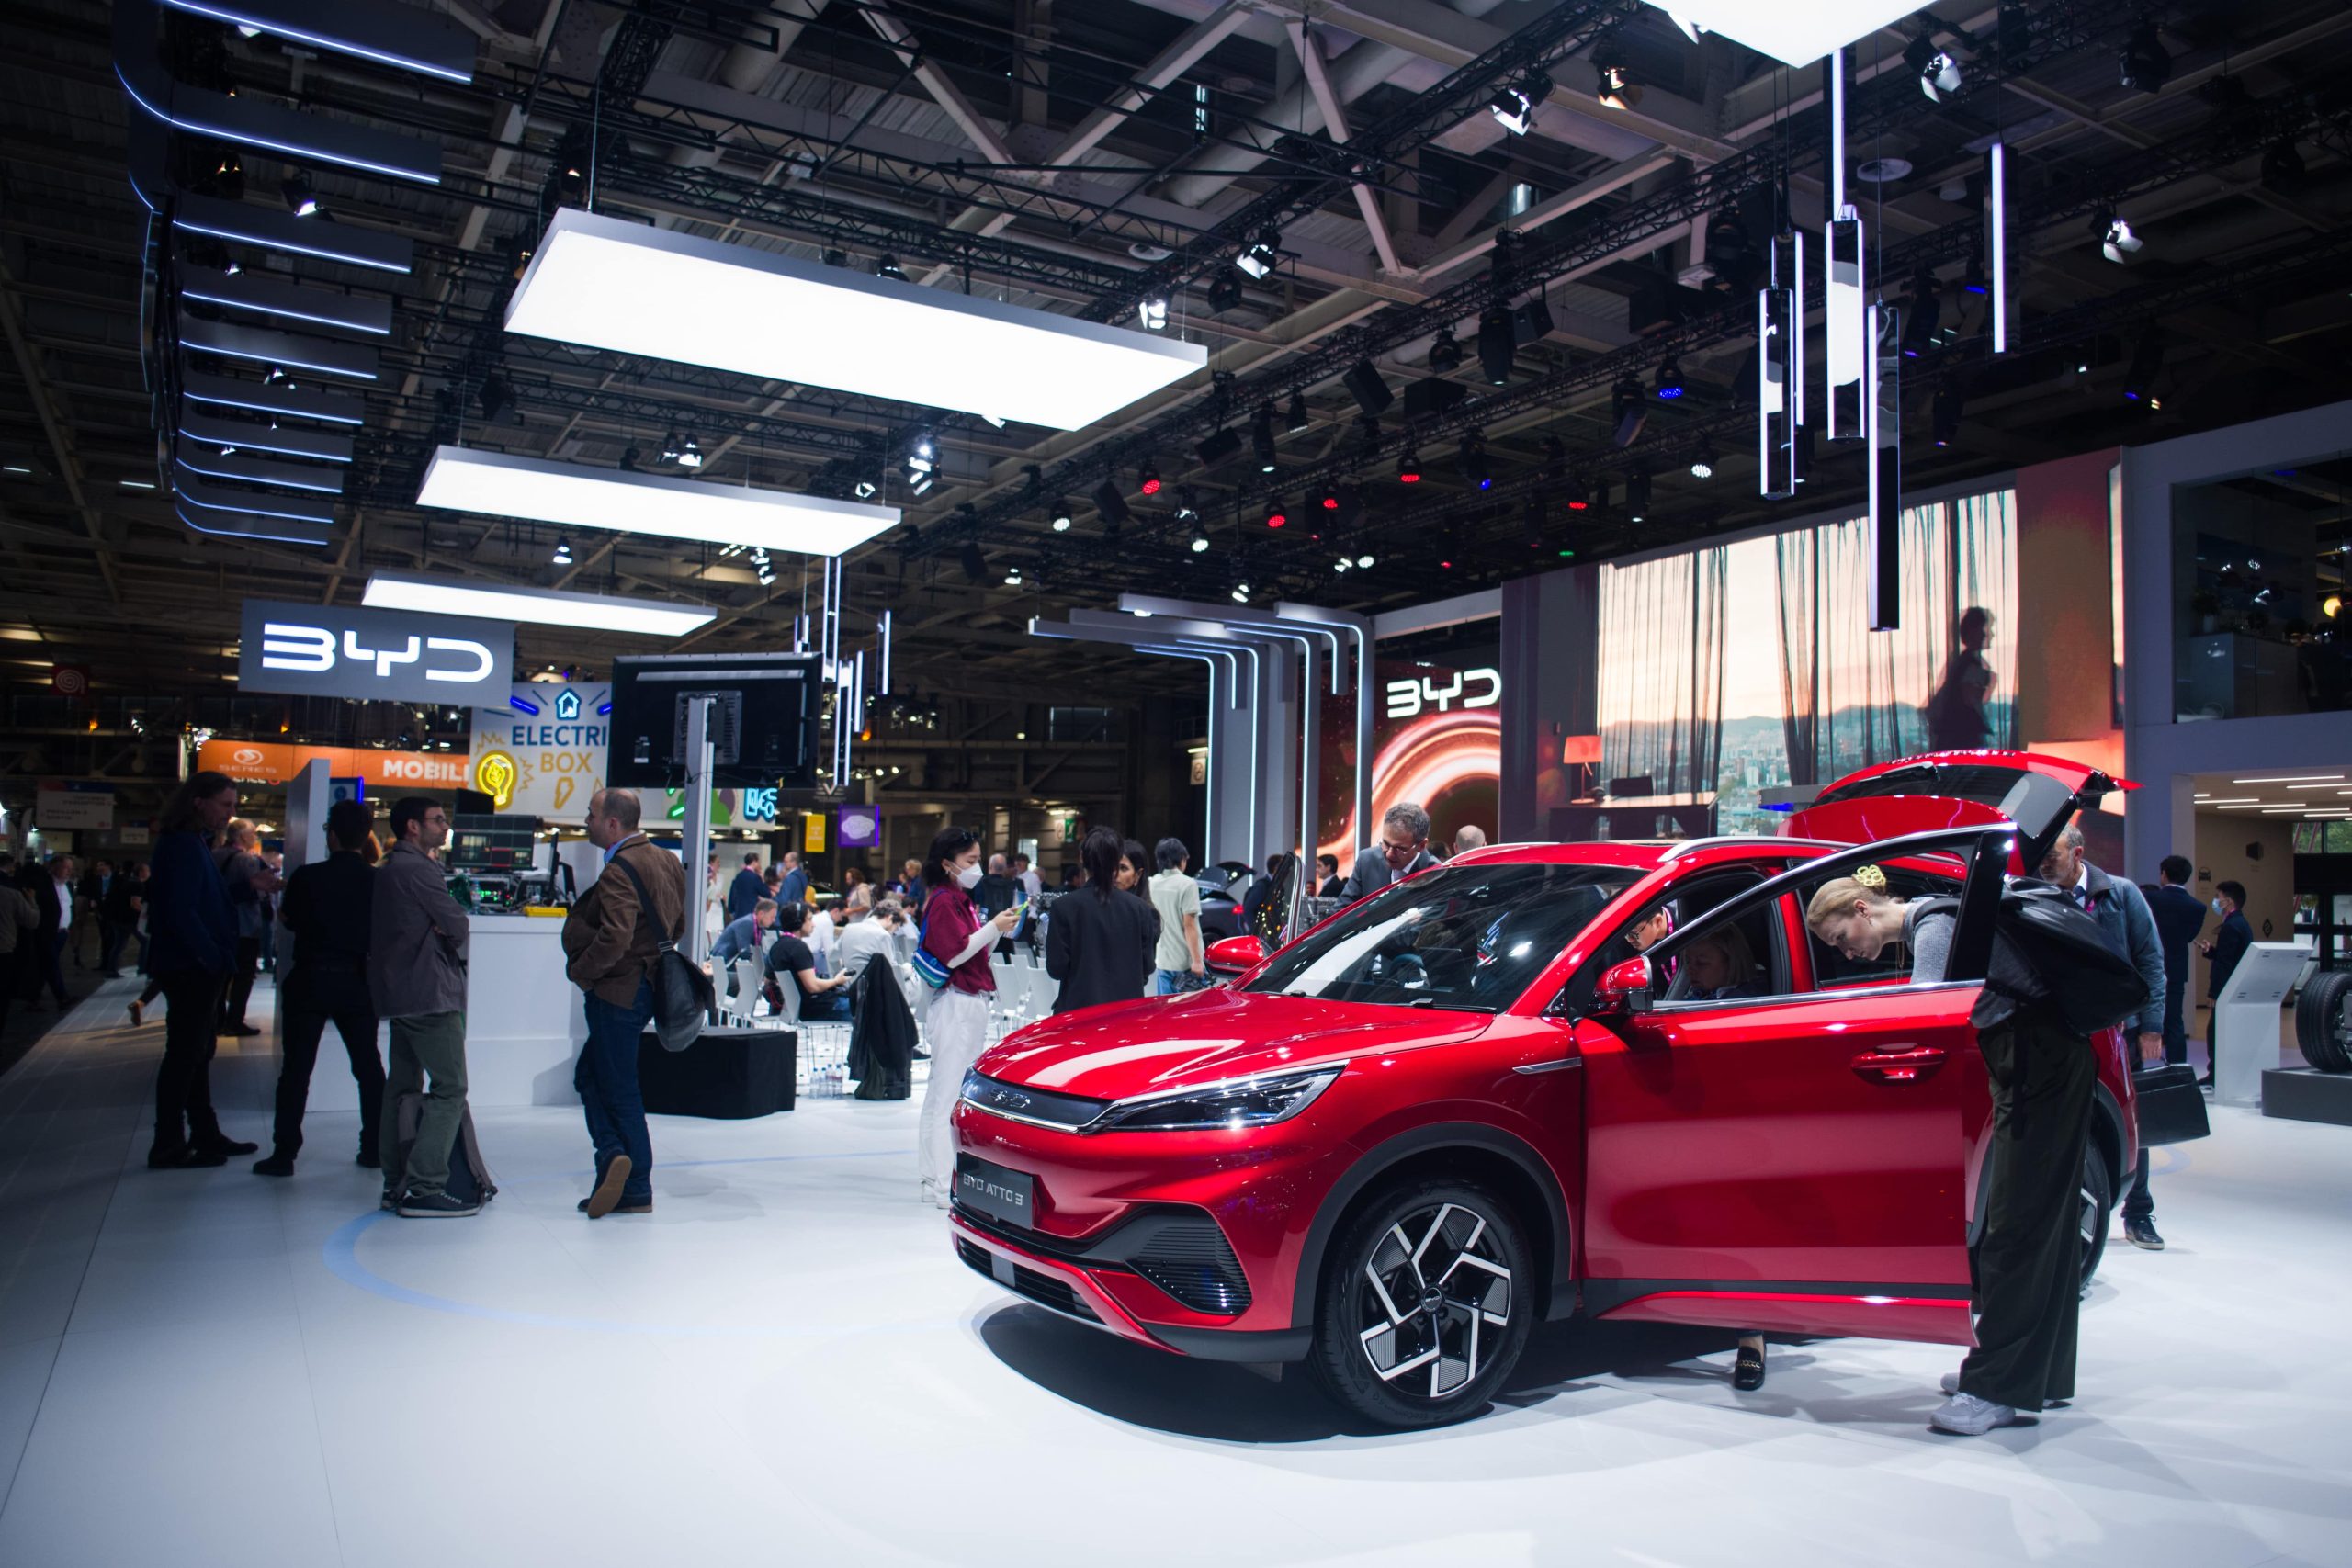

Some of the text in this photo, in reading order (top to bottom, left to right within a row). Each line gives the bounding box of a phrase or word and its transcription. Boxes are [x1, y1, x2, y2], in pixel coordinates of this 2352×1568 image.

[262, 622, 494, 682] BYD
[1387, 668, 1501, 718] BYD
[512, 725, 607, 747] ELECTRI
[540, 752, 593, 773] BOX
[964, 1172, 984, 1190] BYD
[986, 1182, 1013, 1203] ATTO
